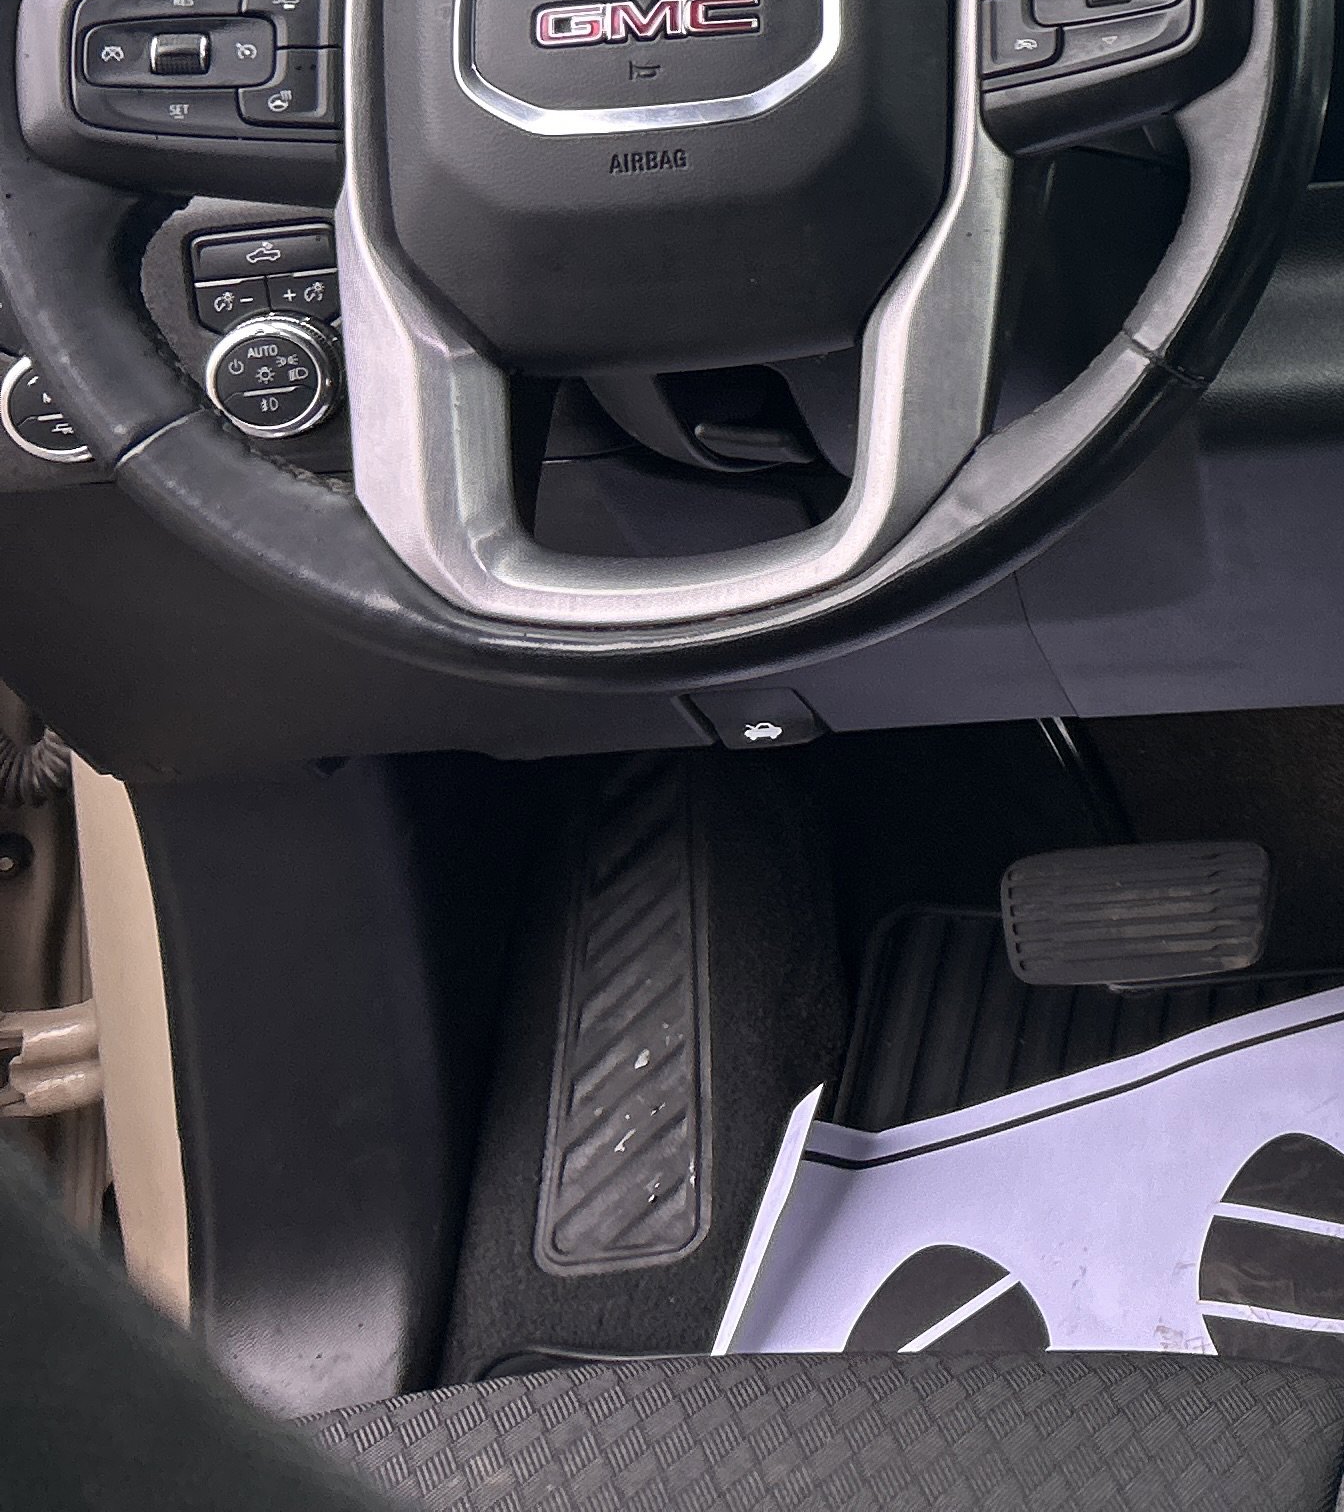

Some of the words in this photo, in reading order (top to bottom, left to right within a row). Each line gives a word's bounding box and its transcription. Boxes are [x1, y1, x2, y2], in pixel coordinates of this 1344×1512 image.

[169, 104, 190, 116] SET
[608, 148, 688, 175] AIRBAG
[247, 344, 278, 358] AUTO
